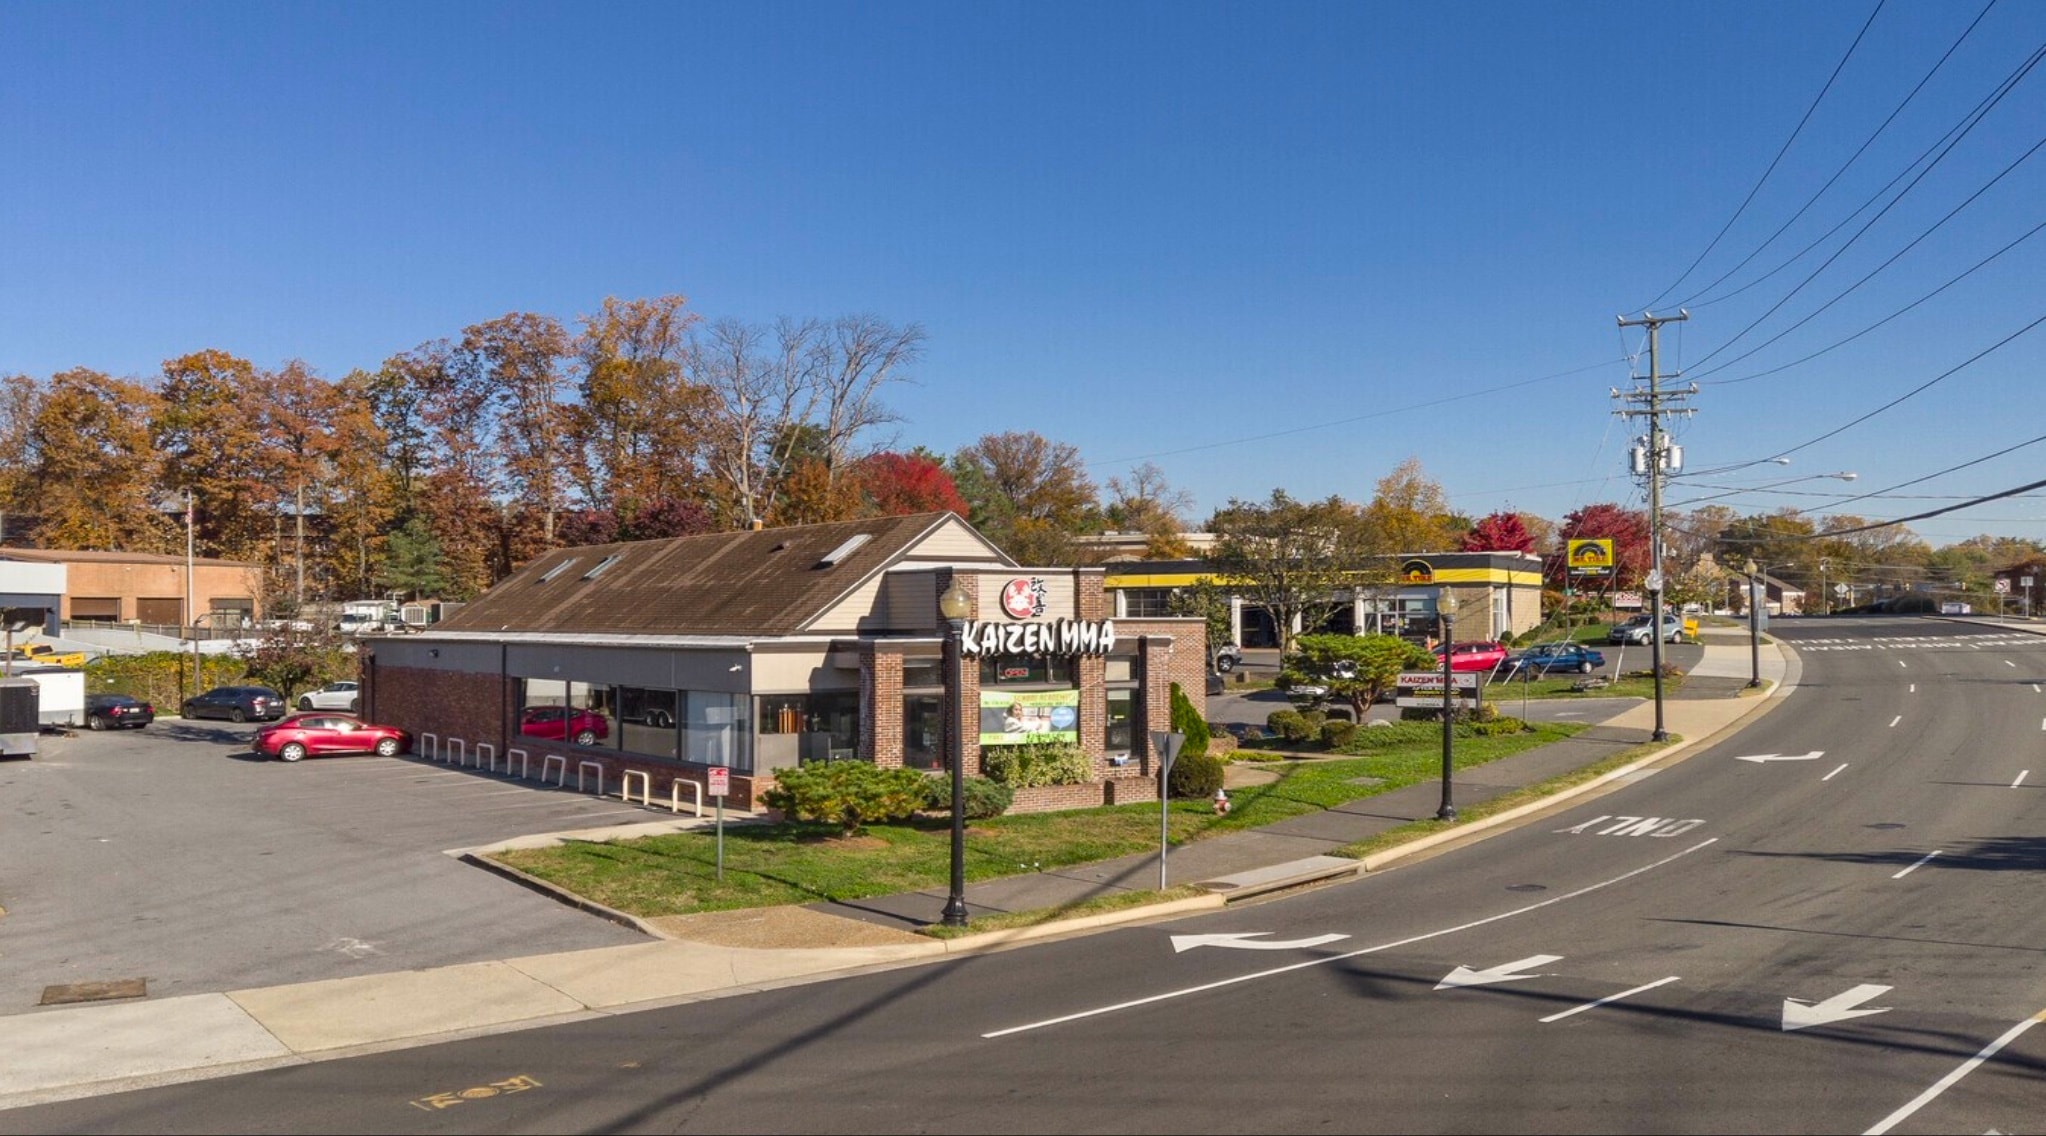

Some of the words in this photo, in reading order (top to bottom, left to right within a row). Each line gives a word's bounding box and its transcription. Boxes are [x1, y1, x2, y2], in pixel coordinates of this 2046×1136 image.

[962, 620, 1056, 655] KAIZEN
[1061, 620, 1115, 653] MMA
[1005, 668, 1027, 677] OPEN
[1401, 676, 1434, 684] KAIZEN
[1552, 815, 1707, 837] ONLY
